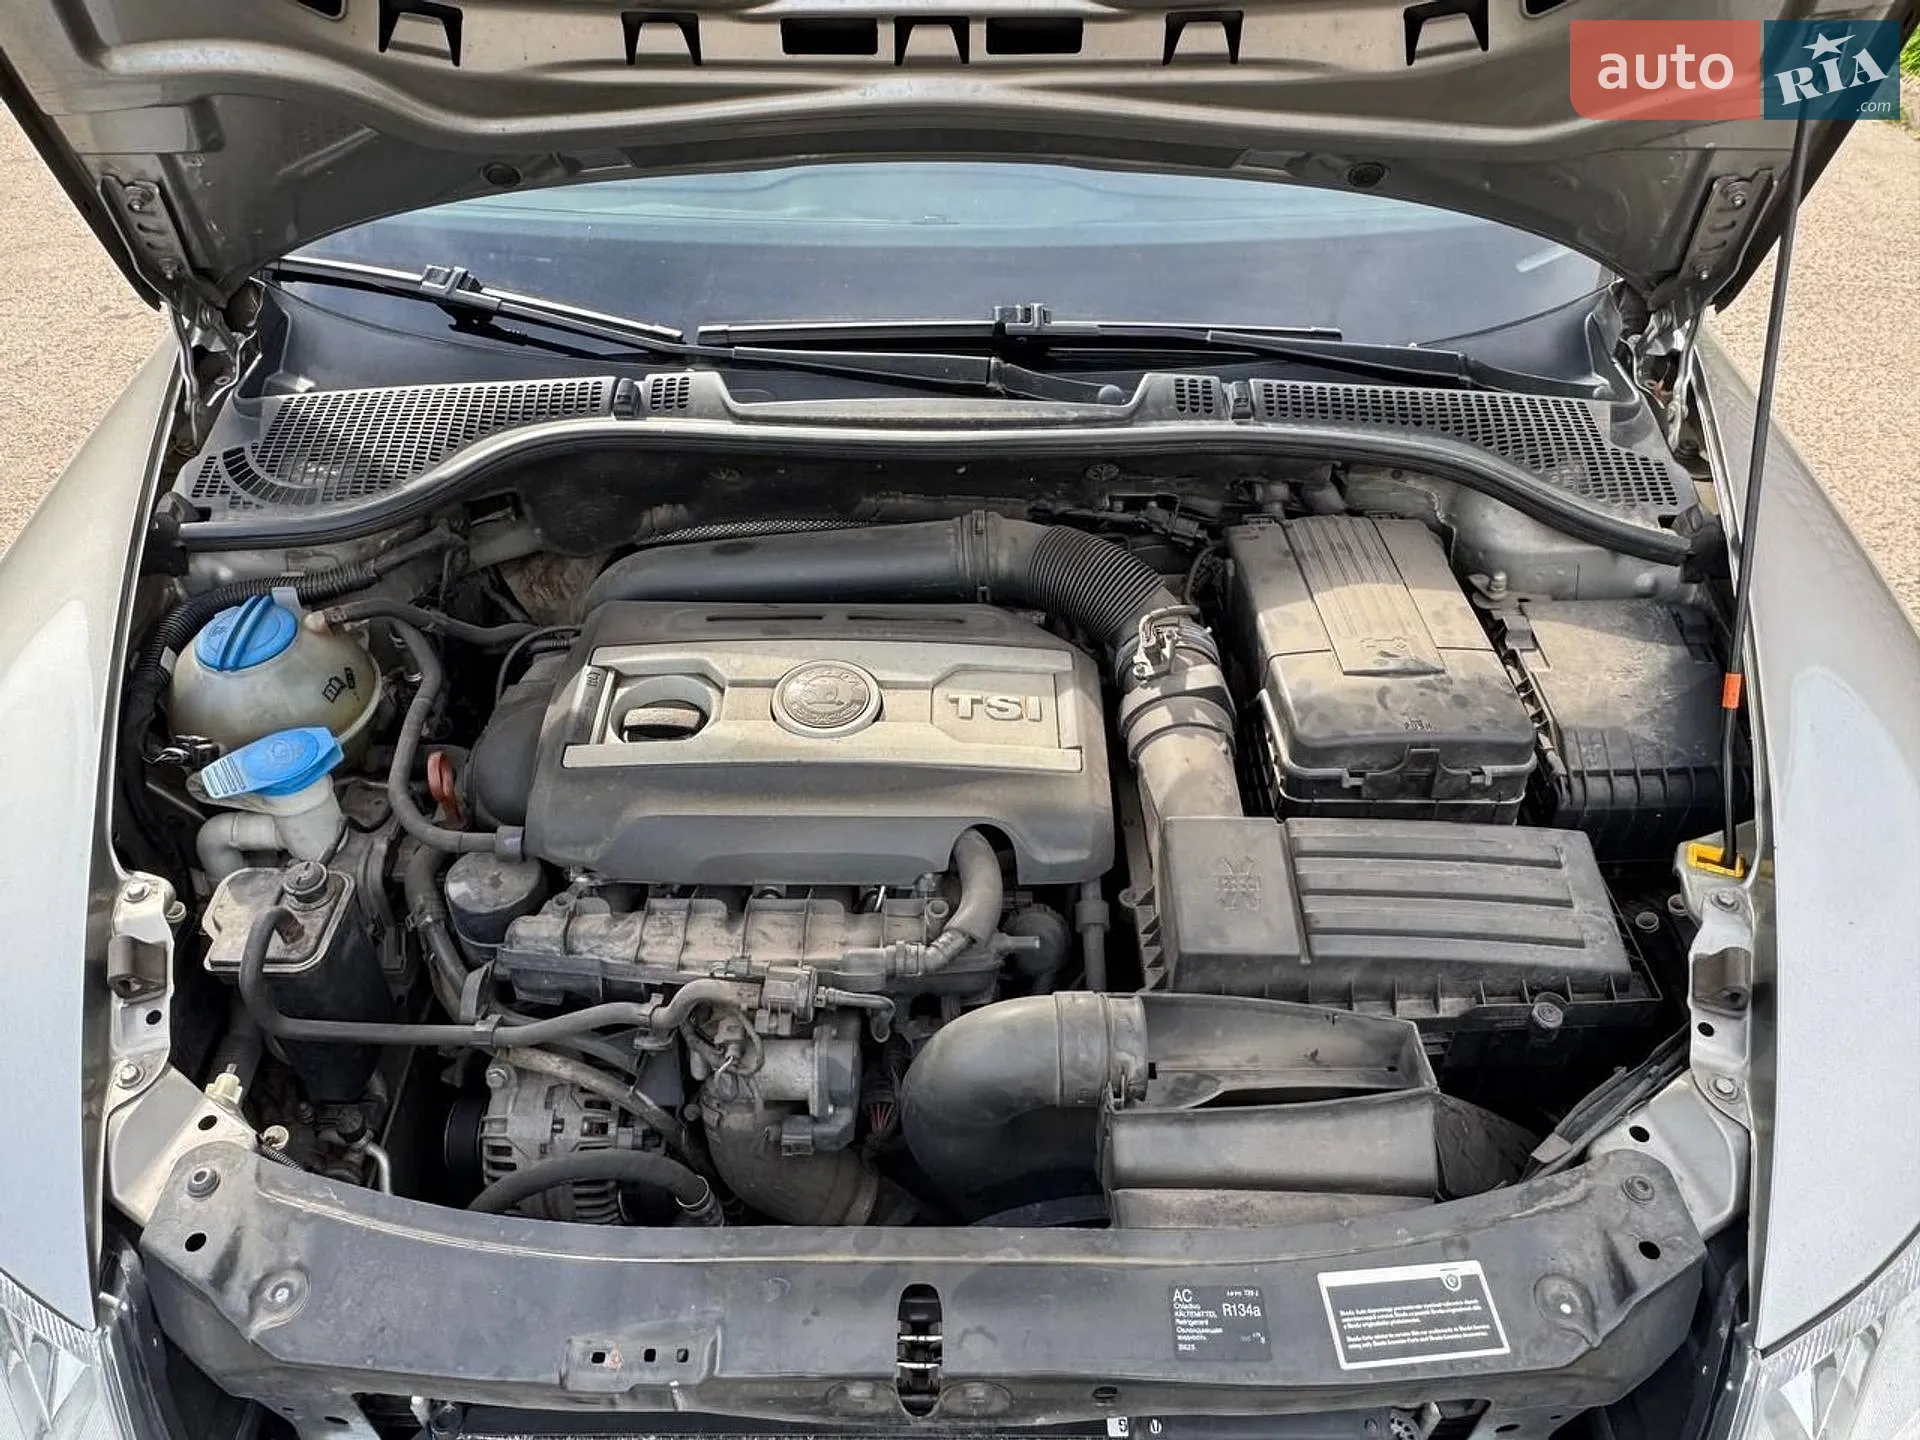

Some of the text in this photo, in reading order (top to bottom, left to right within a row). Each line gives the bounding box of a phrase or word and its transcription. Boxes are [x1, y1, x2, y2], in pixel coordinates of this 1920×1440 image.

[947, 694, 1042, 722] TSI
[1173, 1288, 1193, 1303] AC
[1222, 1303, 1262, 1317] R134a
